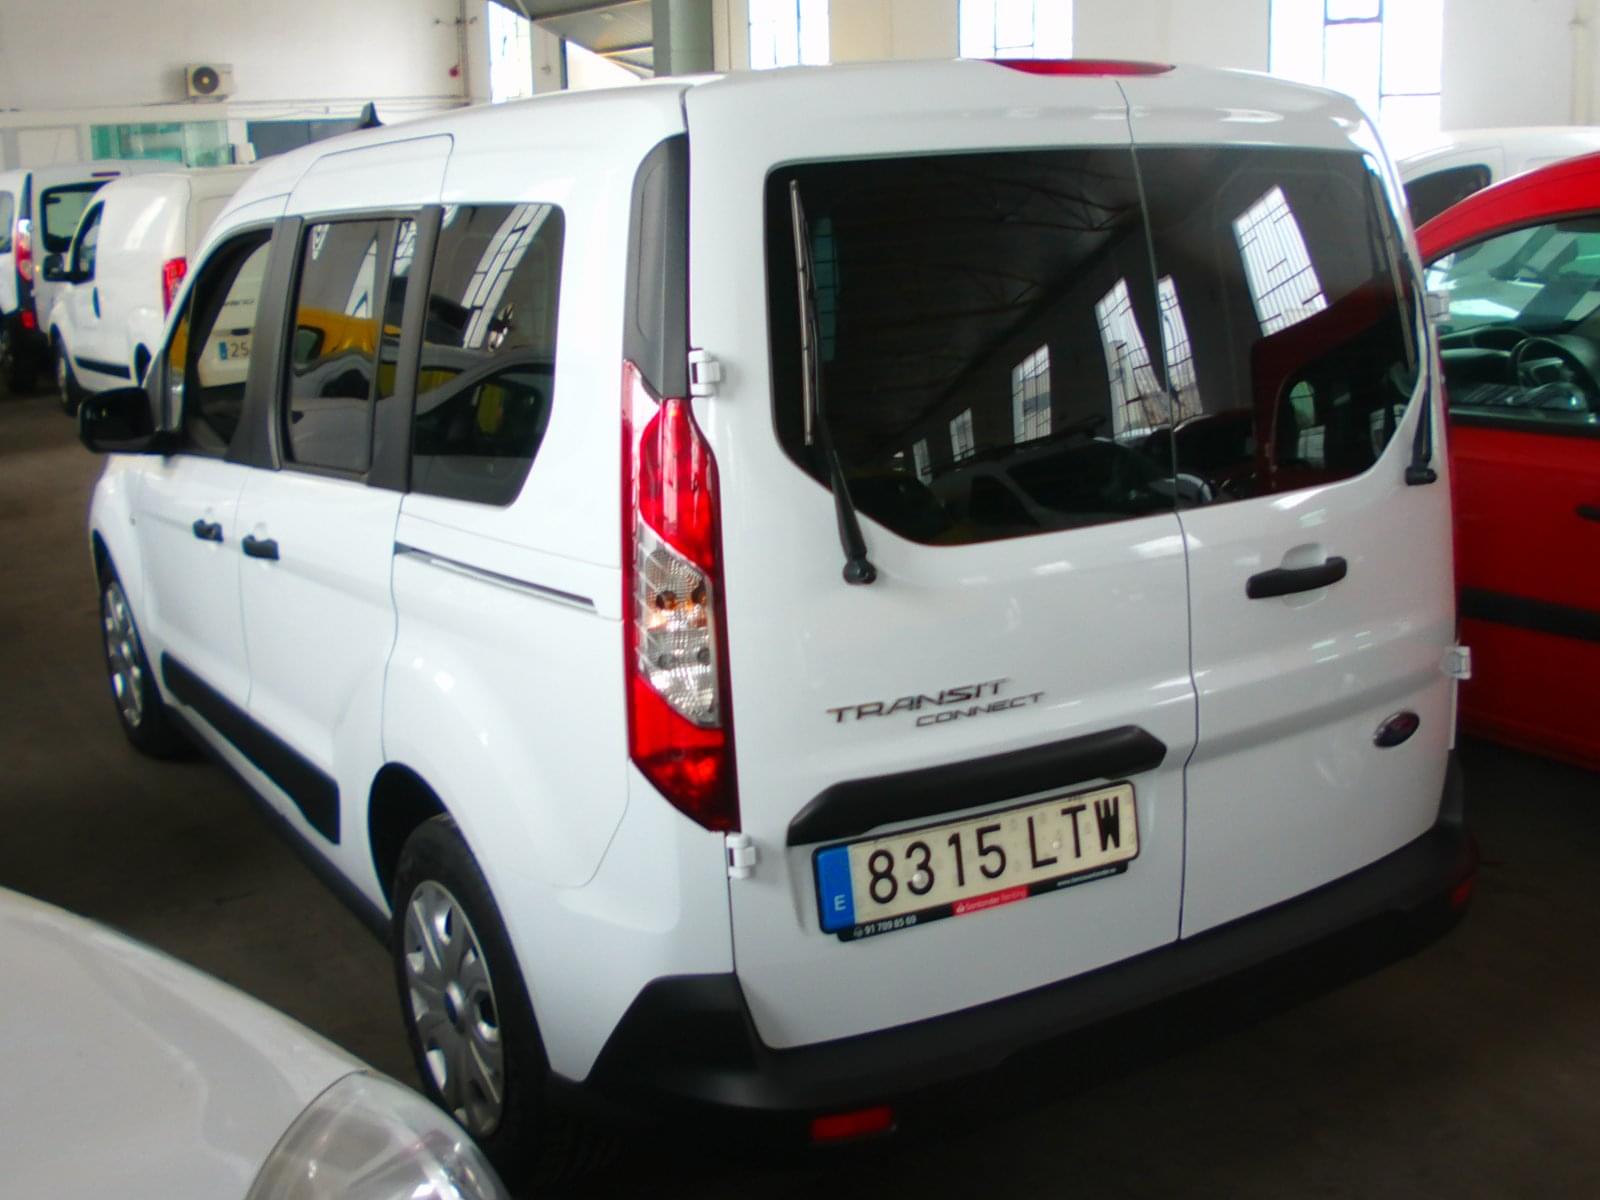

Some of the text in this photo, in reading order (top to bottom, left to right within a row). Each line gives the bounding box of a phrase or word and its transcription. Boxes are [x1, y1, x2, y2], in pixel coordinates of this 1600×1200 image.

[826, 678, 1012, 723] TRANSIT
[916, 692, 1045, 727] CONNECT
[868, 796, 1121, 904] 8315 LTW
[834, 895, 846, 911] E
